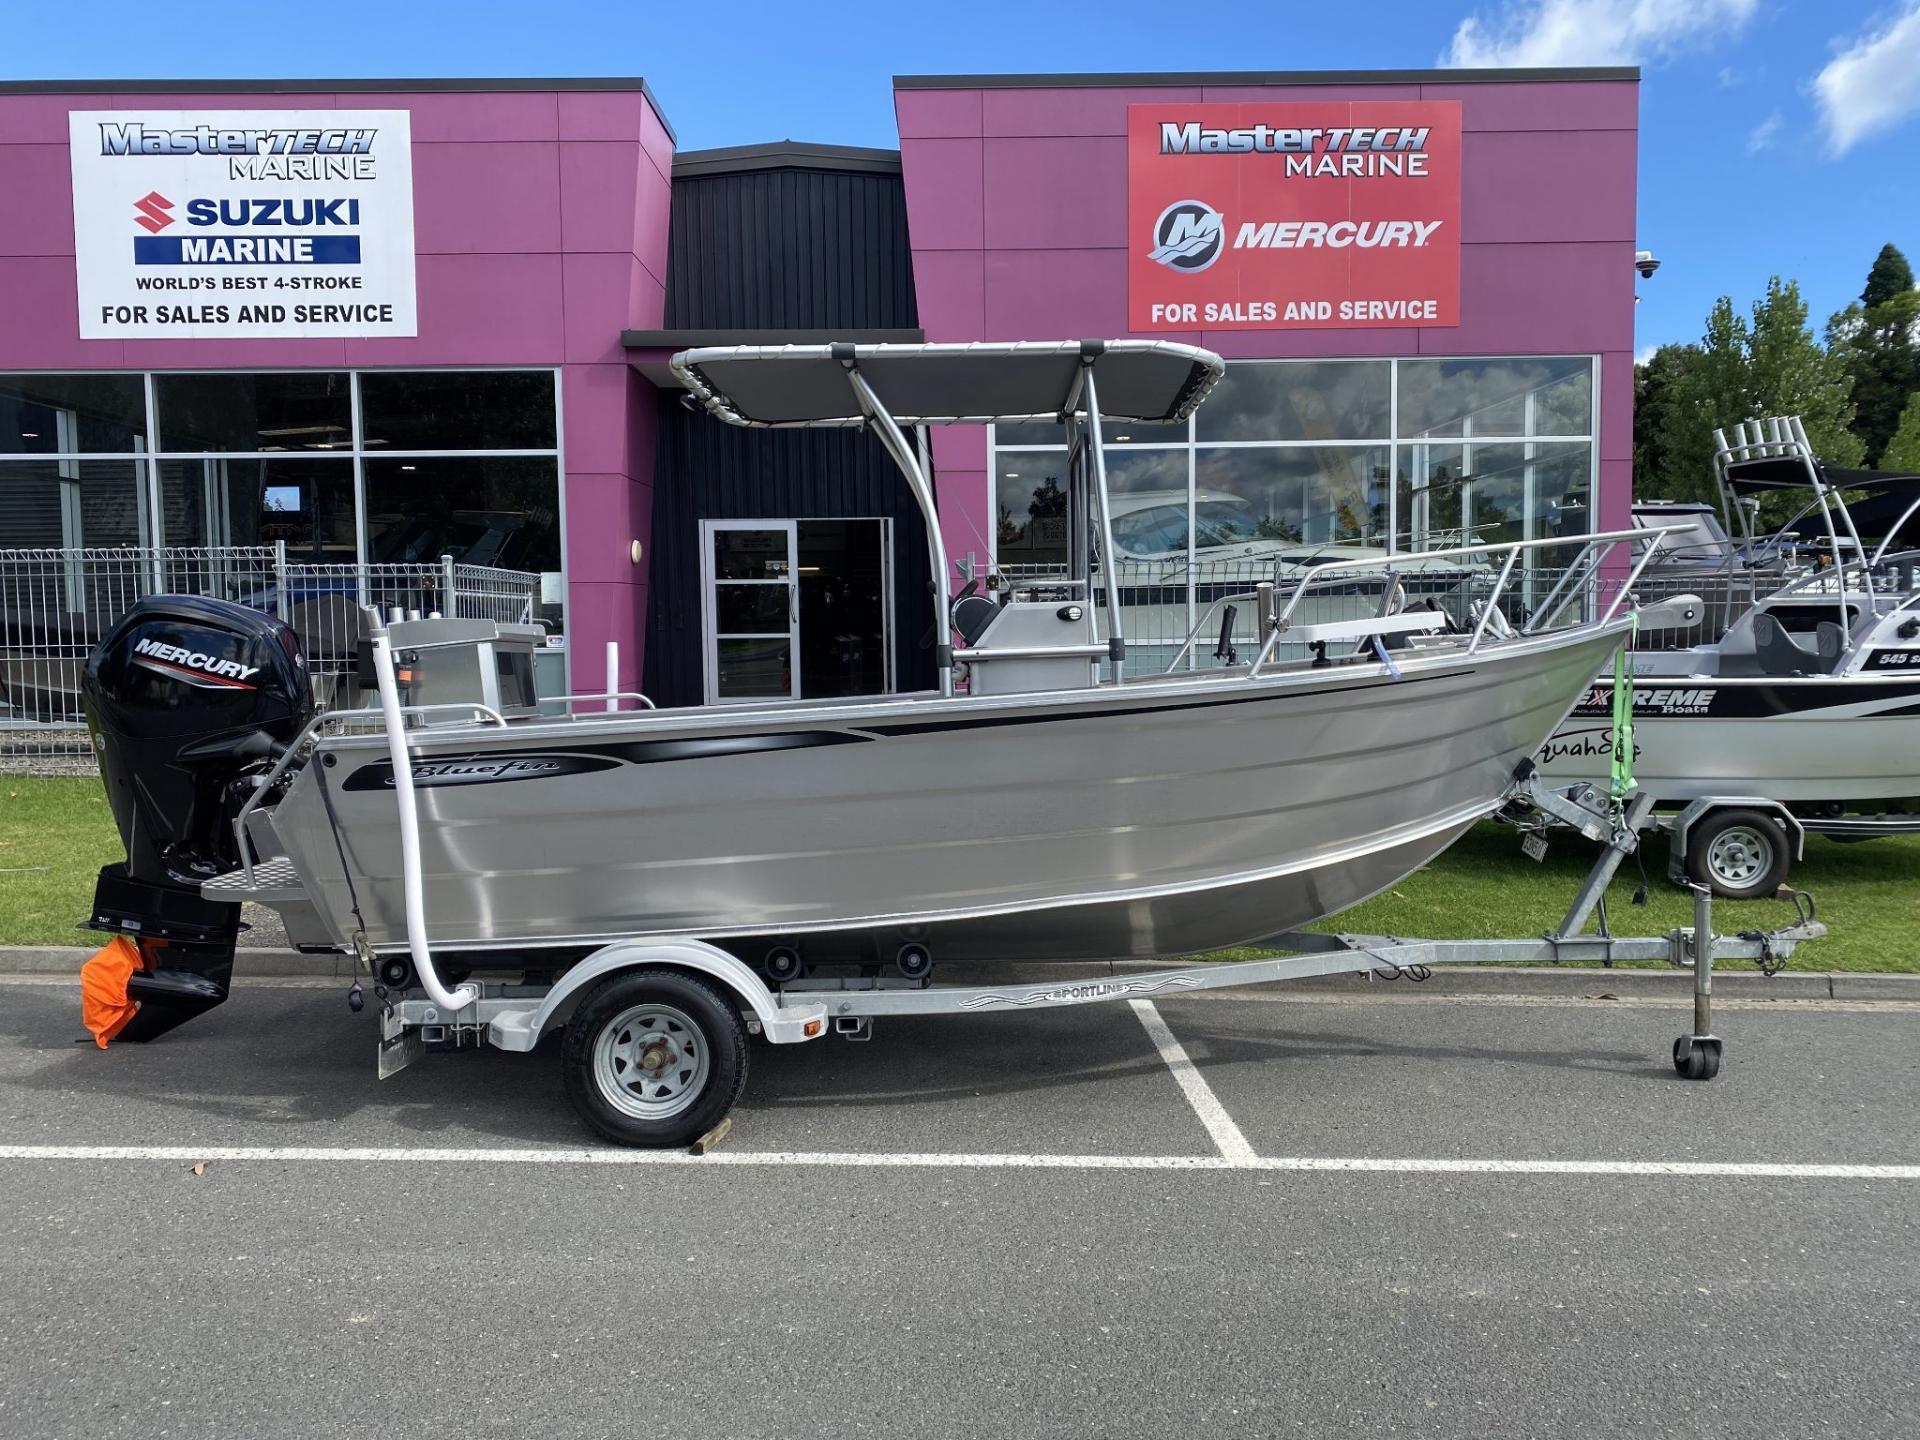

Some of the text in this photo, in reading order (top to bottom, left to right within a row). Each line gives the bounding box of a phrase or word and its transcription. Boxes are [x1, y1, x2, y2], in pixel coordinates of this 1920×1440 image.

[97, 122, 379, 156] MasterTECH
[1159, 122, 1432, 154] MasterTECH
[229, 155, 377, 180] MARINE
[1285, 153, 1429, 178] MARINE
[186, 198, 359, 226] SUZUKI
[1233, 221, 1443, 248] MERCURY
[181, 238, 313, 263] MARINE
[136, 276, 362, 290] WORLD'S BEST 4-STROKE
[102, 304, 393, 324] FOR SALES AND SERVICE
[1151, 300, 1437, 323] FOR SALES AND SERVICE
[134, 638, 260, 680] MERCURY
[1879, 653, 1909, 664] 545
[1577, 688, 1718, 706] EXREME
[1661, 705, 1709, 713] Boats
[385, 760, 560, 784] Bluefin
